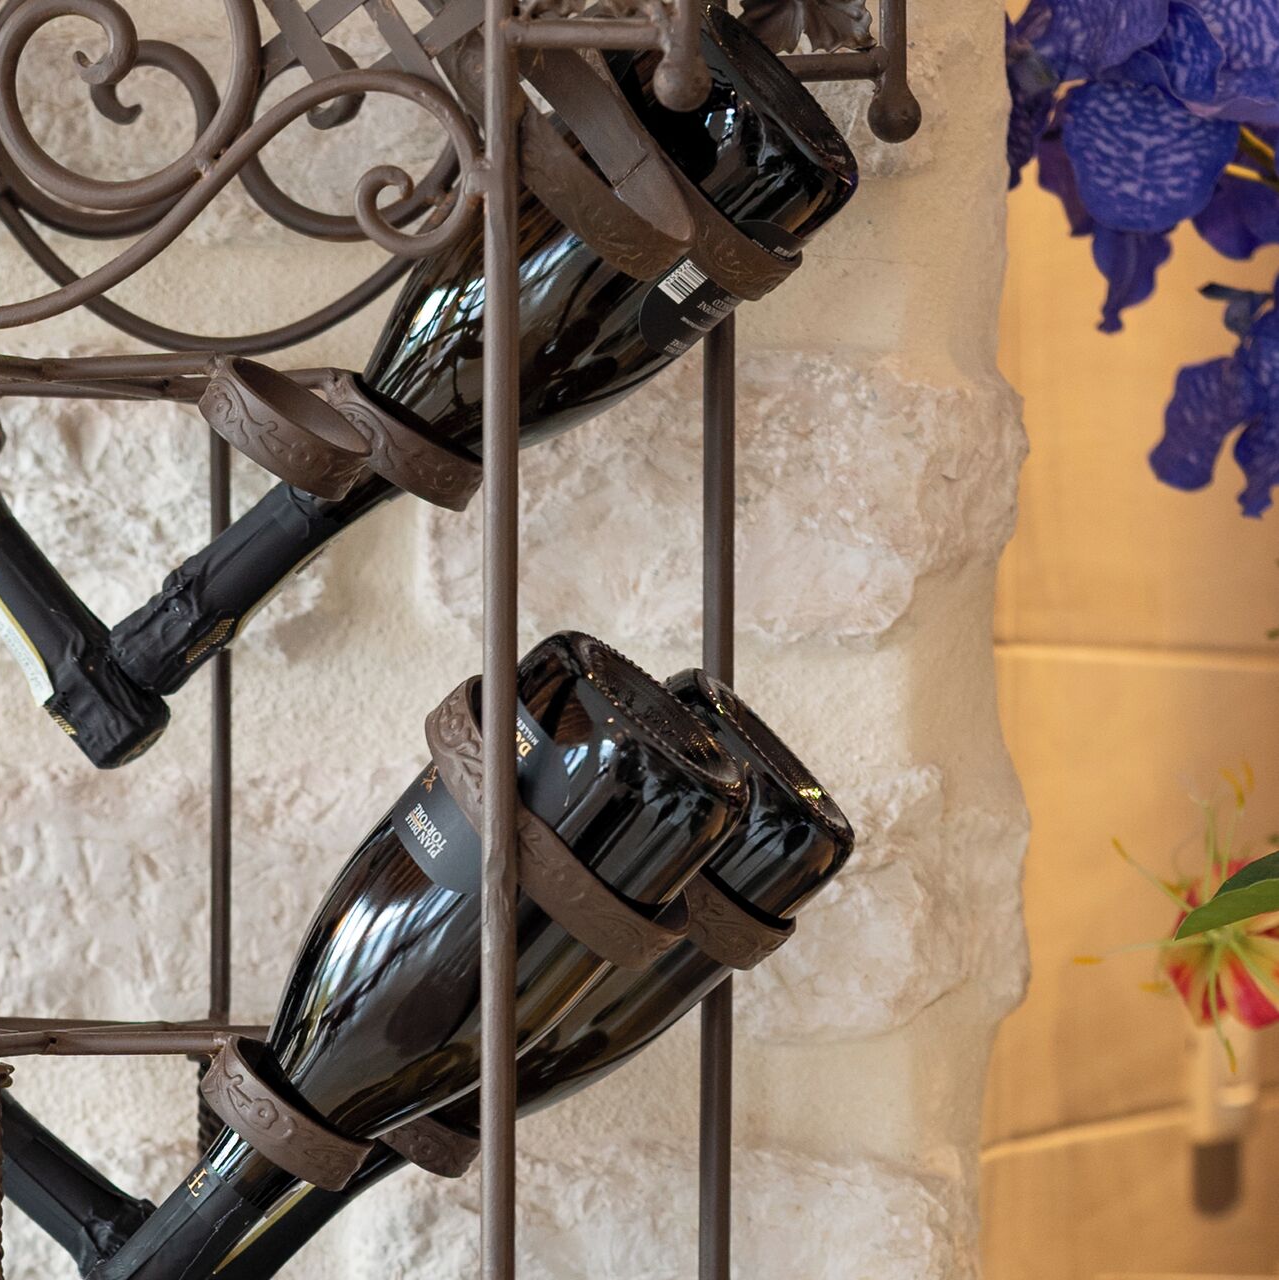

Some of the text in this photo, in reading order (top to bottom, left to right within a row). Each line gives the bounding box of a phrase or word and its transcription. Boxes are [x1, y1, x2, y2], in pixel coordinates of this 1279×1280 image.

[404, 813, 440, 859] PIAN DELLE
[413, 803, 447, 851] TORTORE
